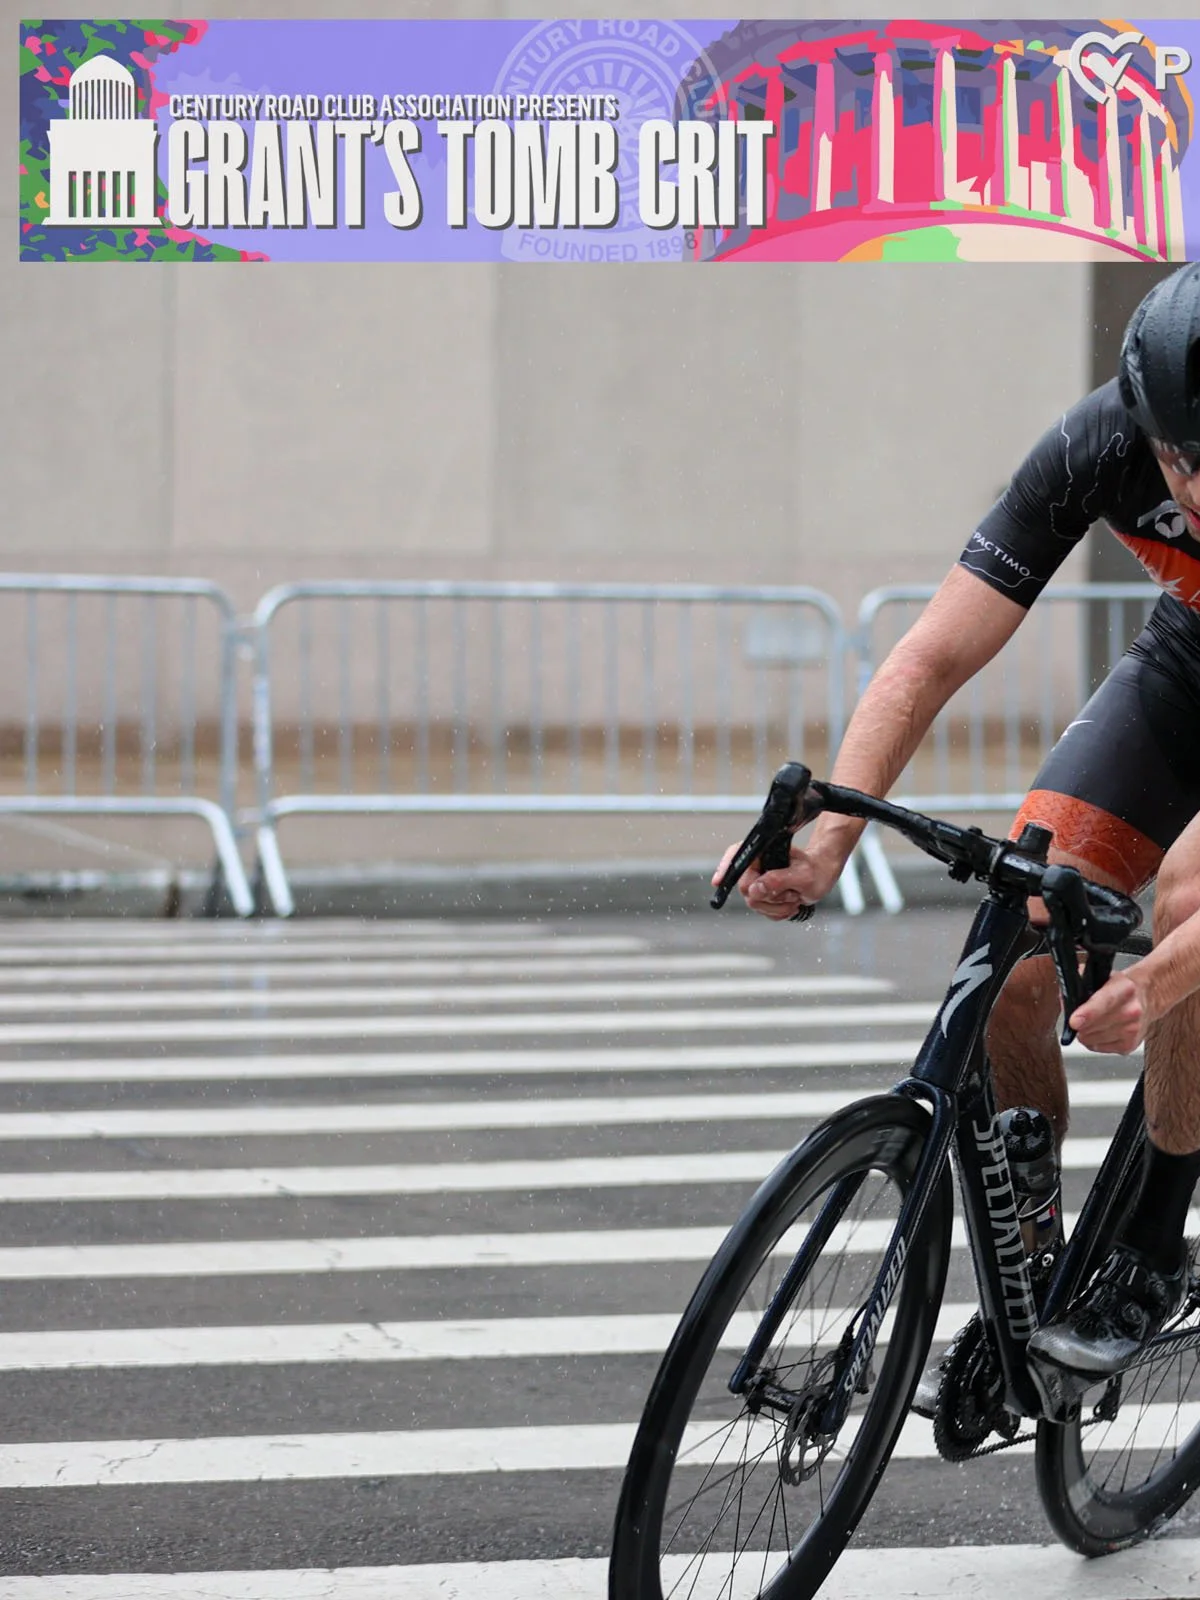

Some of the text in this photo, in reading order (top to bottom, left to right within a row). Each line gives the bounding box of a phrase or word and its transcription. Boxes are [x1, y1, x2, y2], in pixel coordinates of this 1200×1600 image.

[973, 532, 1030, 577] PACTIMO
[972, 1113, 1040, 1340] SPECIALIZED
[843, 1235, 907, 1393] SPECIALIZED
